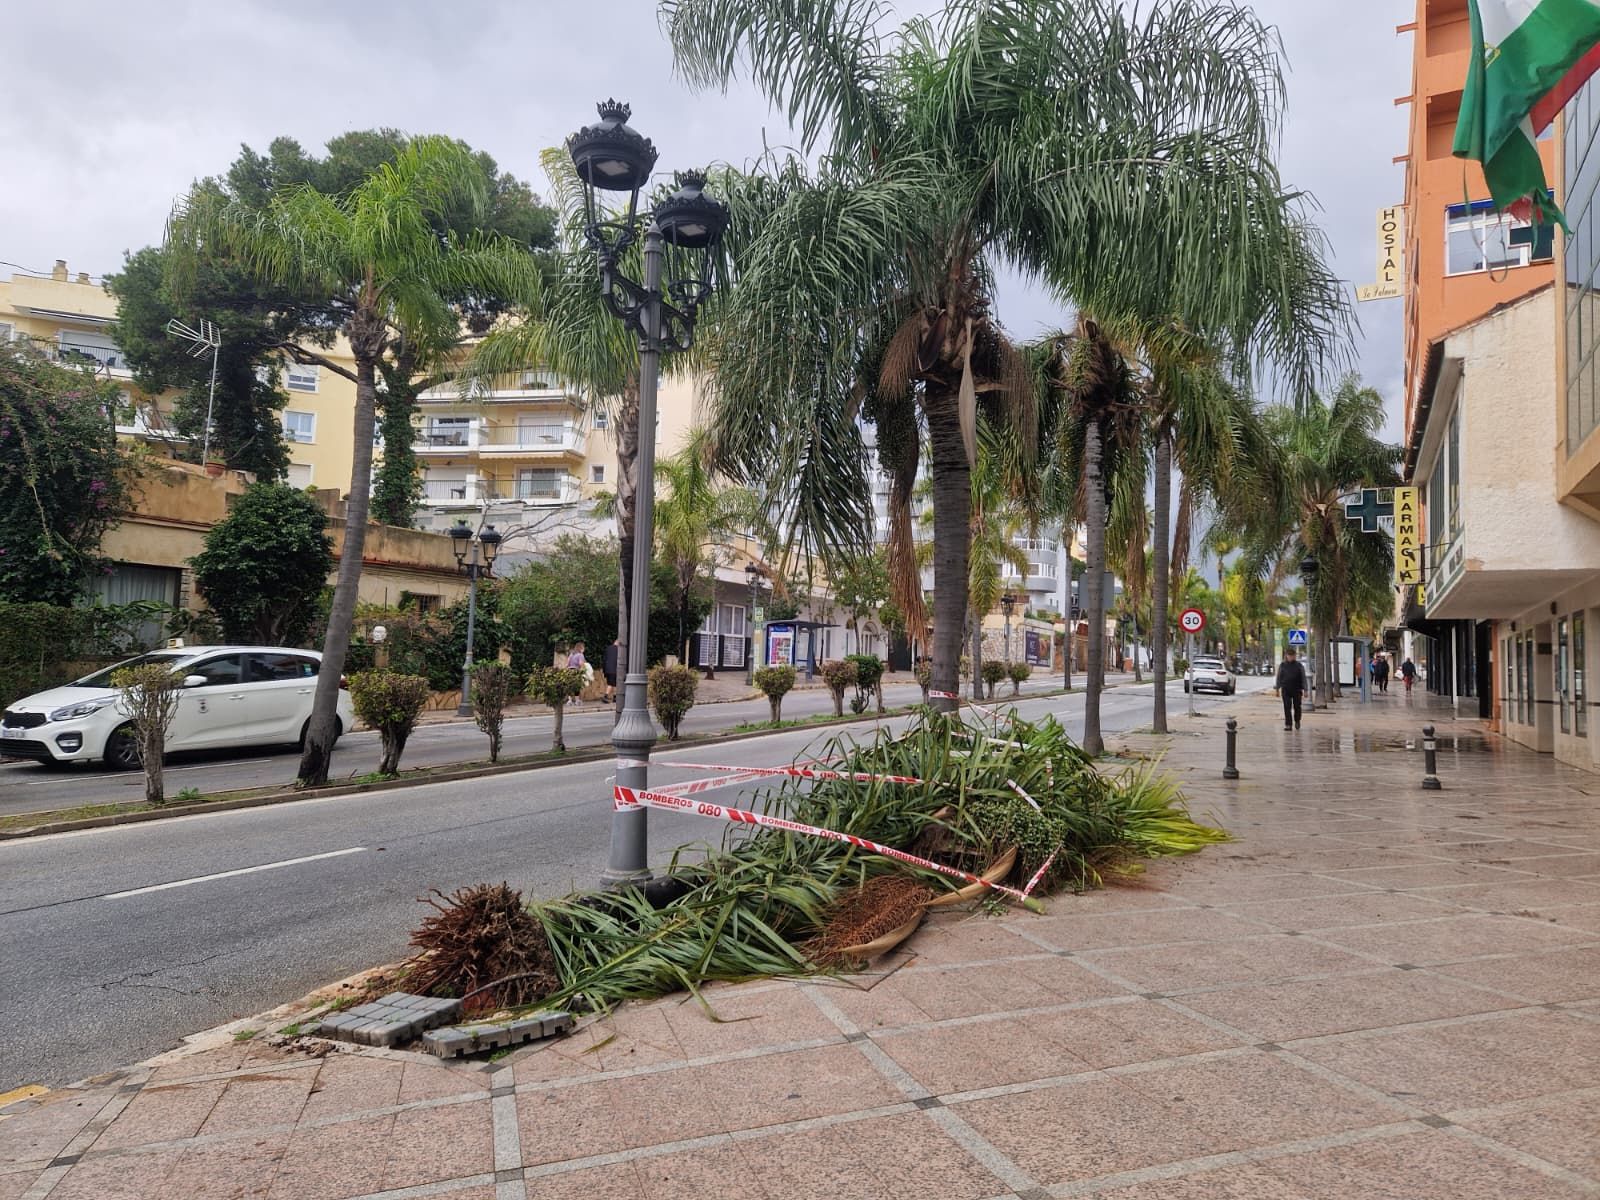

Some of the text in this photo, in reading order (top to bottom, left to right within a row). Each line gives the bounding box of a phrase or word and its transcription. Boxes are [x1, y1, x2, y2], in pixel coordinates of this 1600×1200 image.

[1382, 209, 1397, 281] HOSTAL
[1184, 616, 1200, 625] 30
[639, 791, 693, 808] BOMBEROS
[698, 803, 722, 817] 080
[761, 816, 814, 833] BOMBEROS
